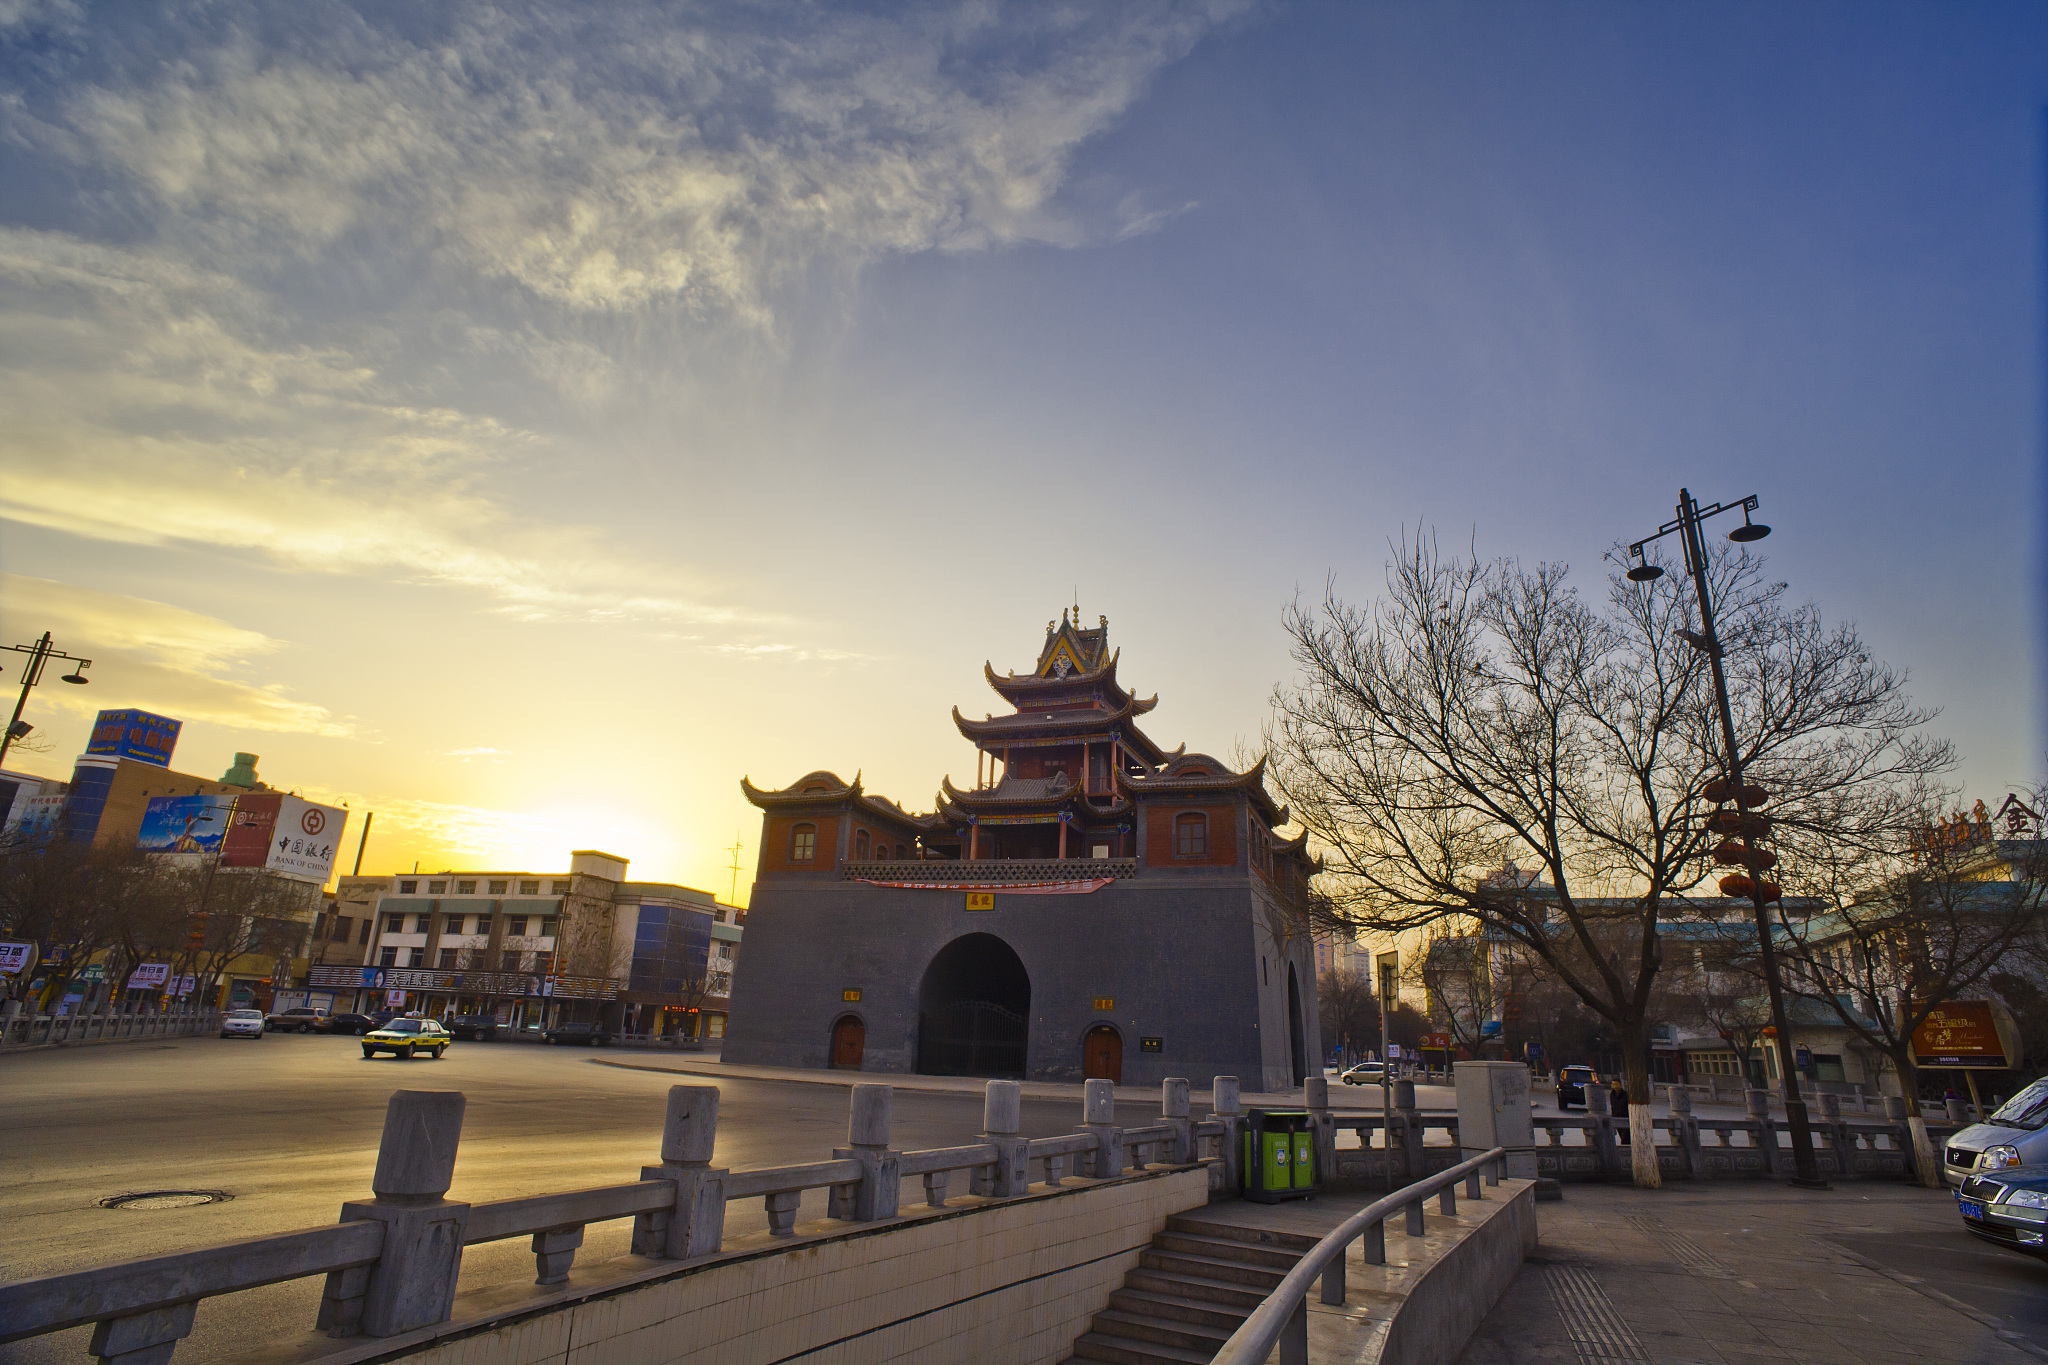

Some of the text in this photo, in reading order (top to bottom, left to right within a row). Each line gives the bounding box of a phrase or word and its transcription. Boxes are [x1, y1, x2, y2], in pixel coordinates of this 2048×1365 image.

[137, 715, 176, 731] 时代广场
[129, 727, 174, 754] 电脑城
[1993, 793, 2044, 834] 金
[279, 836, 333, 861] 中国银行
[275, 856, 329, 872] BANK OF CHINA
